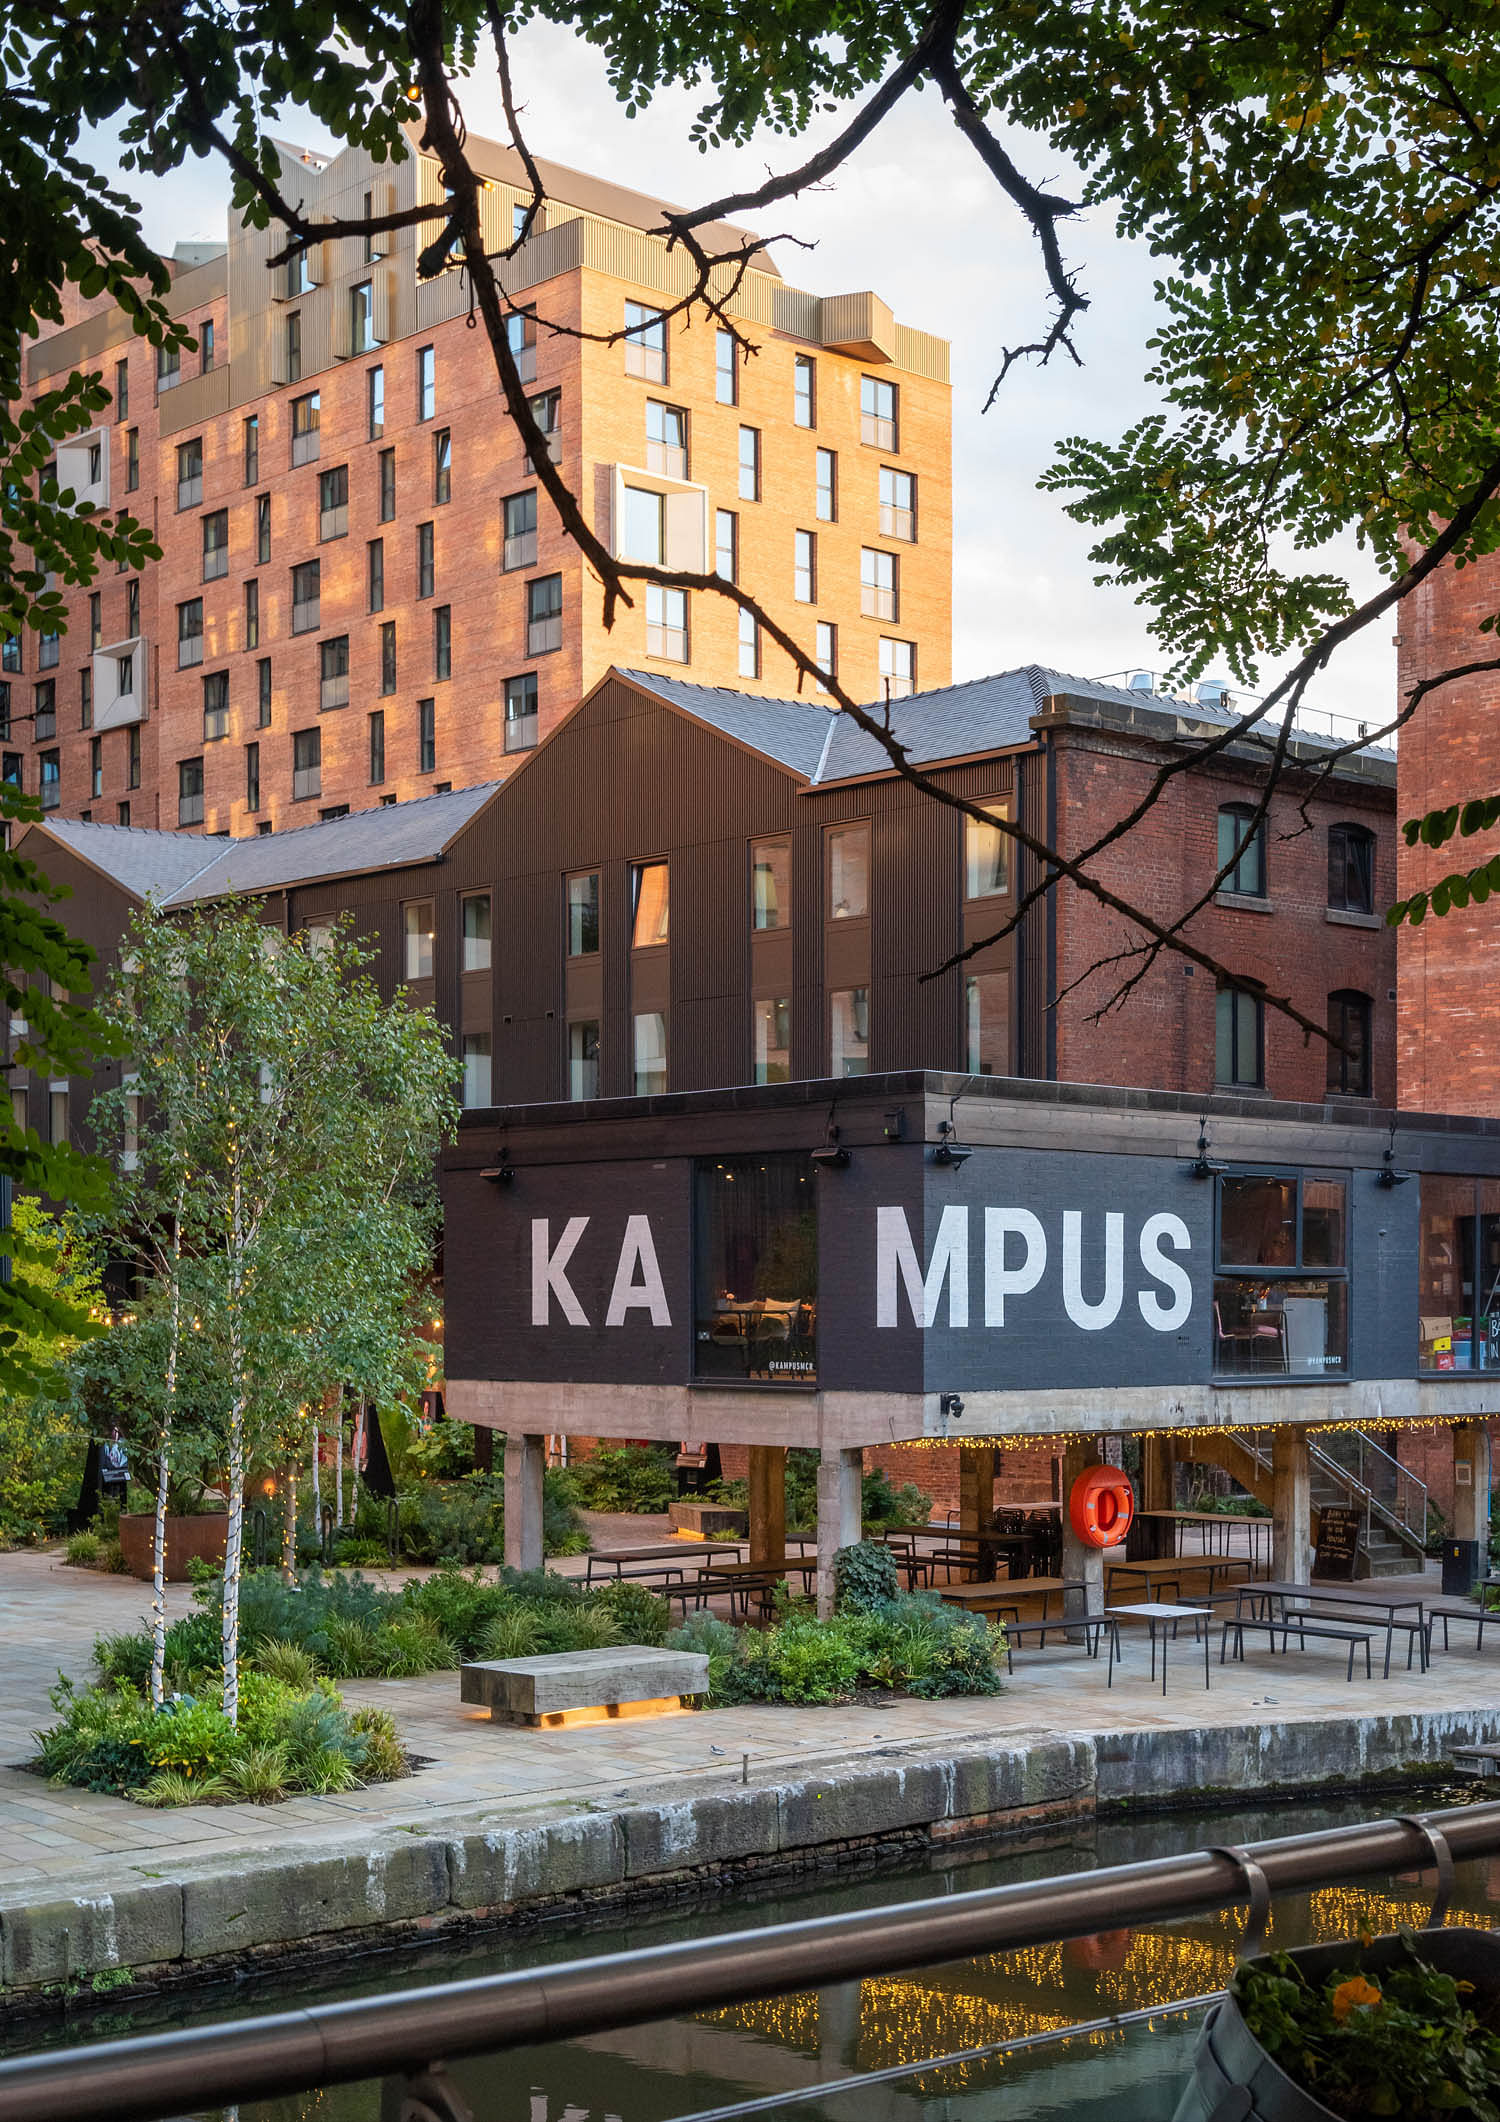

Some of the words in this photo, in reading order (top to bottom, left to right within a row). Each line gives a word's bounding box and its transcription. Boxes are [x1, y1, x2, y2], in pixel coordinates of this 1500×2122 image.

[531, 1215, 672, 1327] KA
[876, 1205, 1193, 1332] MPUS
[769, 1361, 813, 1371] @KAMPUSMCR
